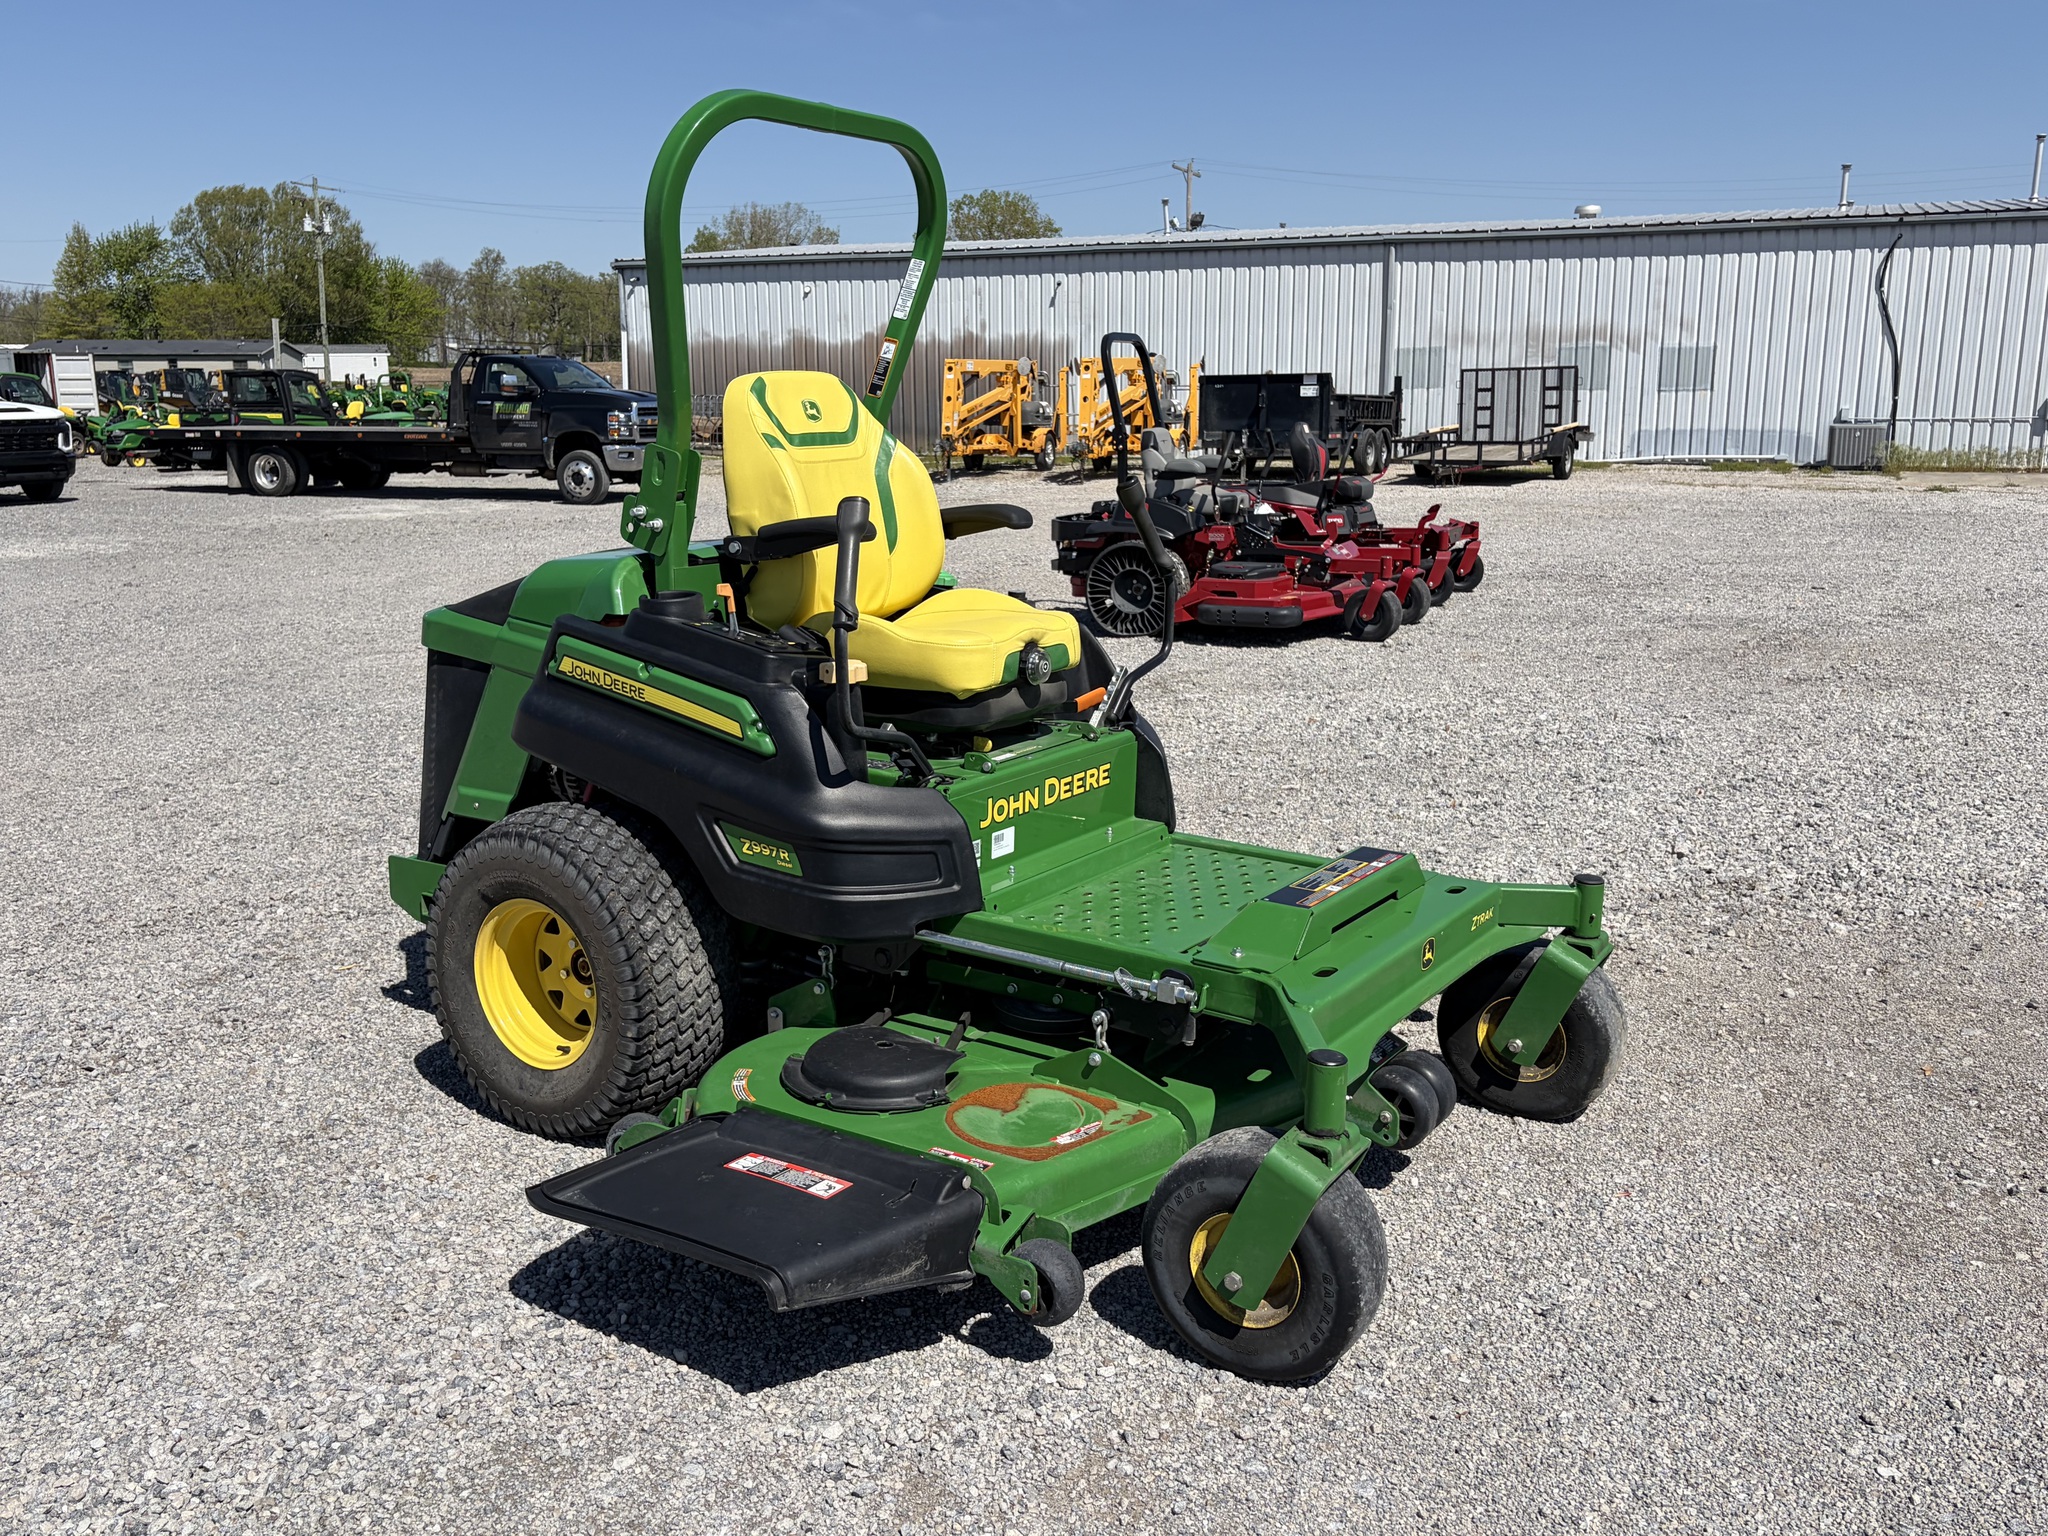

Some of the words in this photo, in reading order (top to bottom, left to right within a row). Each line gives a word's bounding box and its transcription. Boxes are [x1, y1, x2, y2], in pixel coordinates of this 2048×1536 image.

[567, 661, 601, 686] JOHN
[603, 673, 646, 700] DEERE
[979, 786, 1040, 830] JOHN
[1044, 762, 1112, 807] DEERE
[1470, 906, 1495, 932] ZTRAK
[1152, 1180, 1207, 1262] RELIANCE
[1289, 1272, 1335, 1364] CARLISLE
